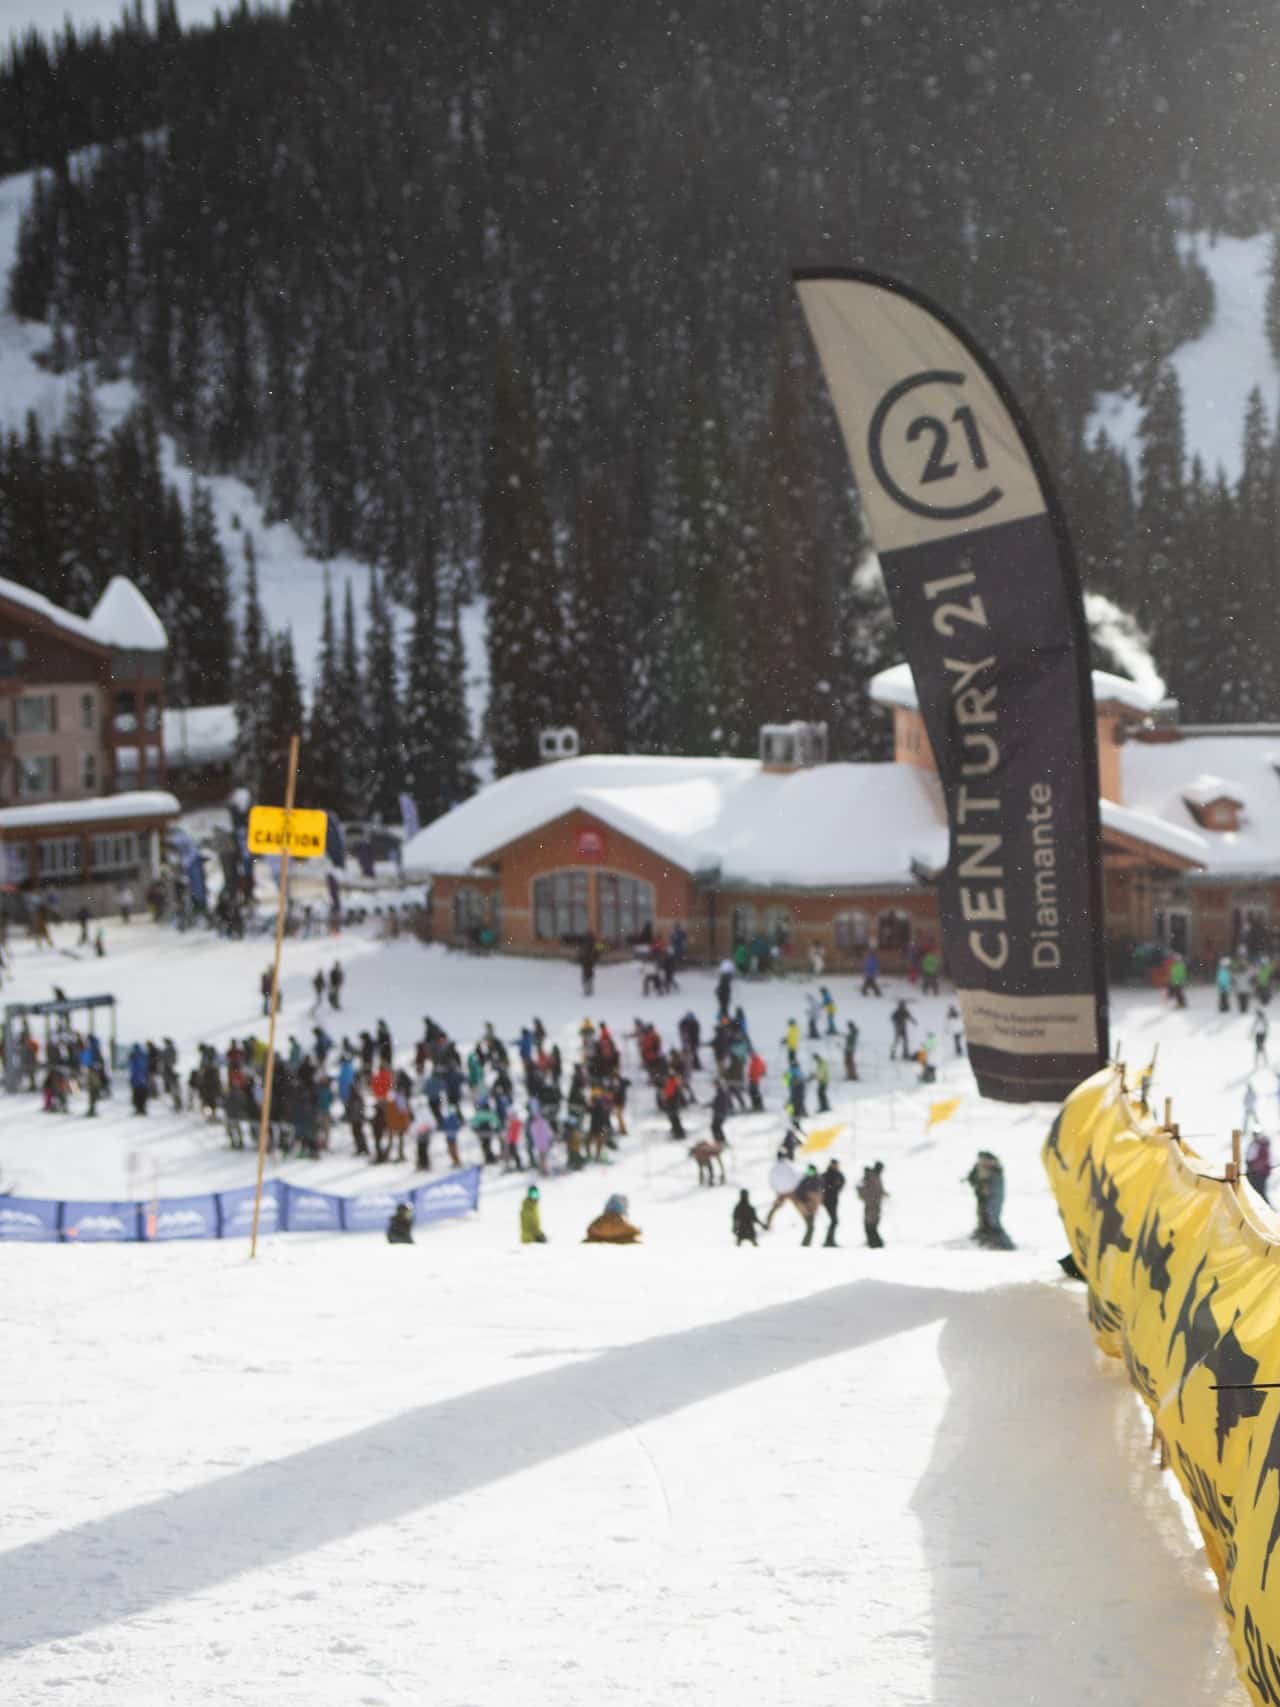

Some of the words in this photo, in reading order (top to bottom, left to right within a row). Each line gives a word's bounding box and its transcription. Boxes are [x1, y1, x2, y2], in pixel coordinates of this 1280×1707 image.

[924, 571, 989, 636] 21
[254, 829, 320, 848] CAUTION
[944, 656, 1009, 971] CENTURY
[1026, 783, 1061, 969] Diamante
